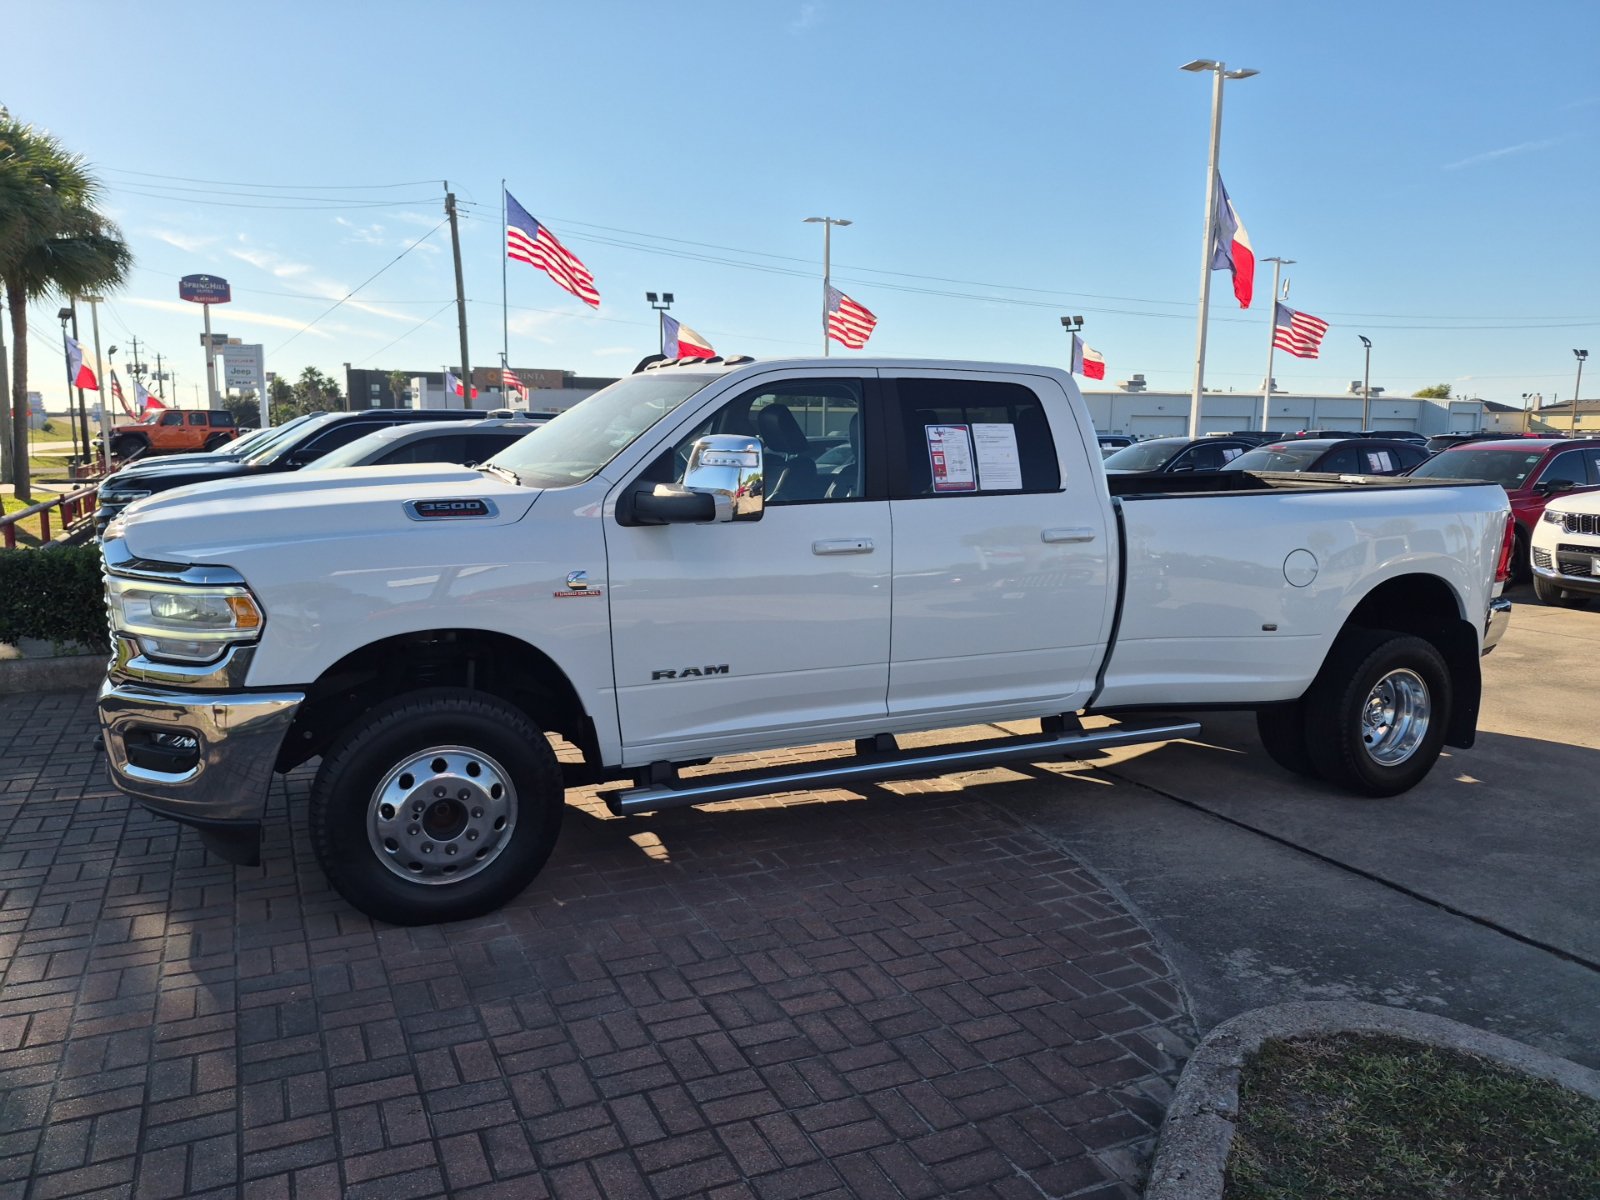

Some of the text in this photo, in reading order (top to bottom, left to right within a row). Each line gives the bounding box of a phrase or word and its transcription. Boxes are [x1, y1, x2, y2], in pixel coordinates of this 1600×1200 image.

[230, 367, 251, 377] Jeep
[420, 502, 480, 511] 3500
[651, 664, 729, 680] RAM
